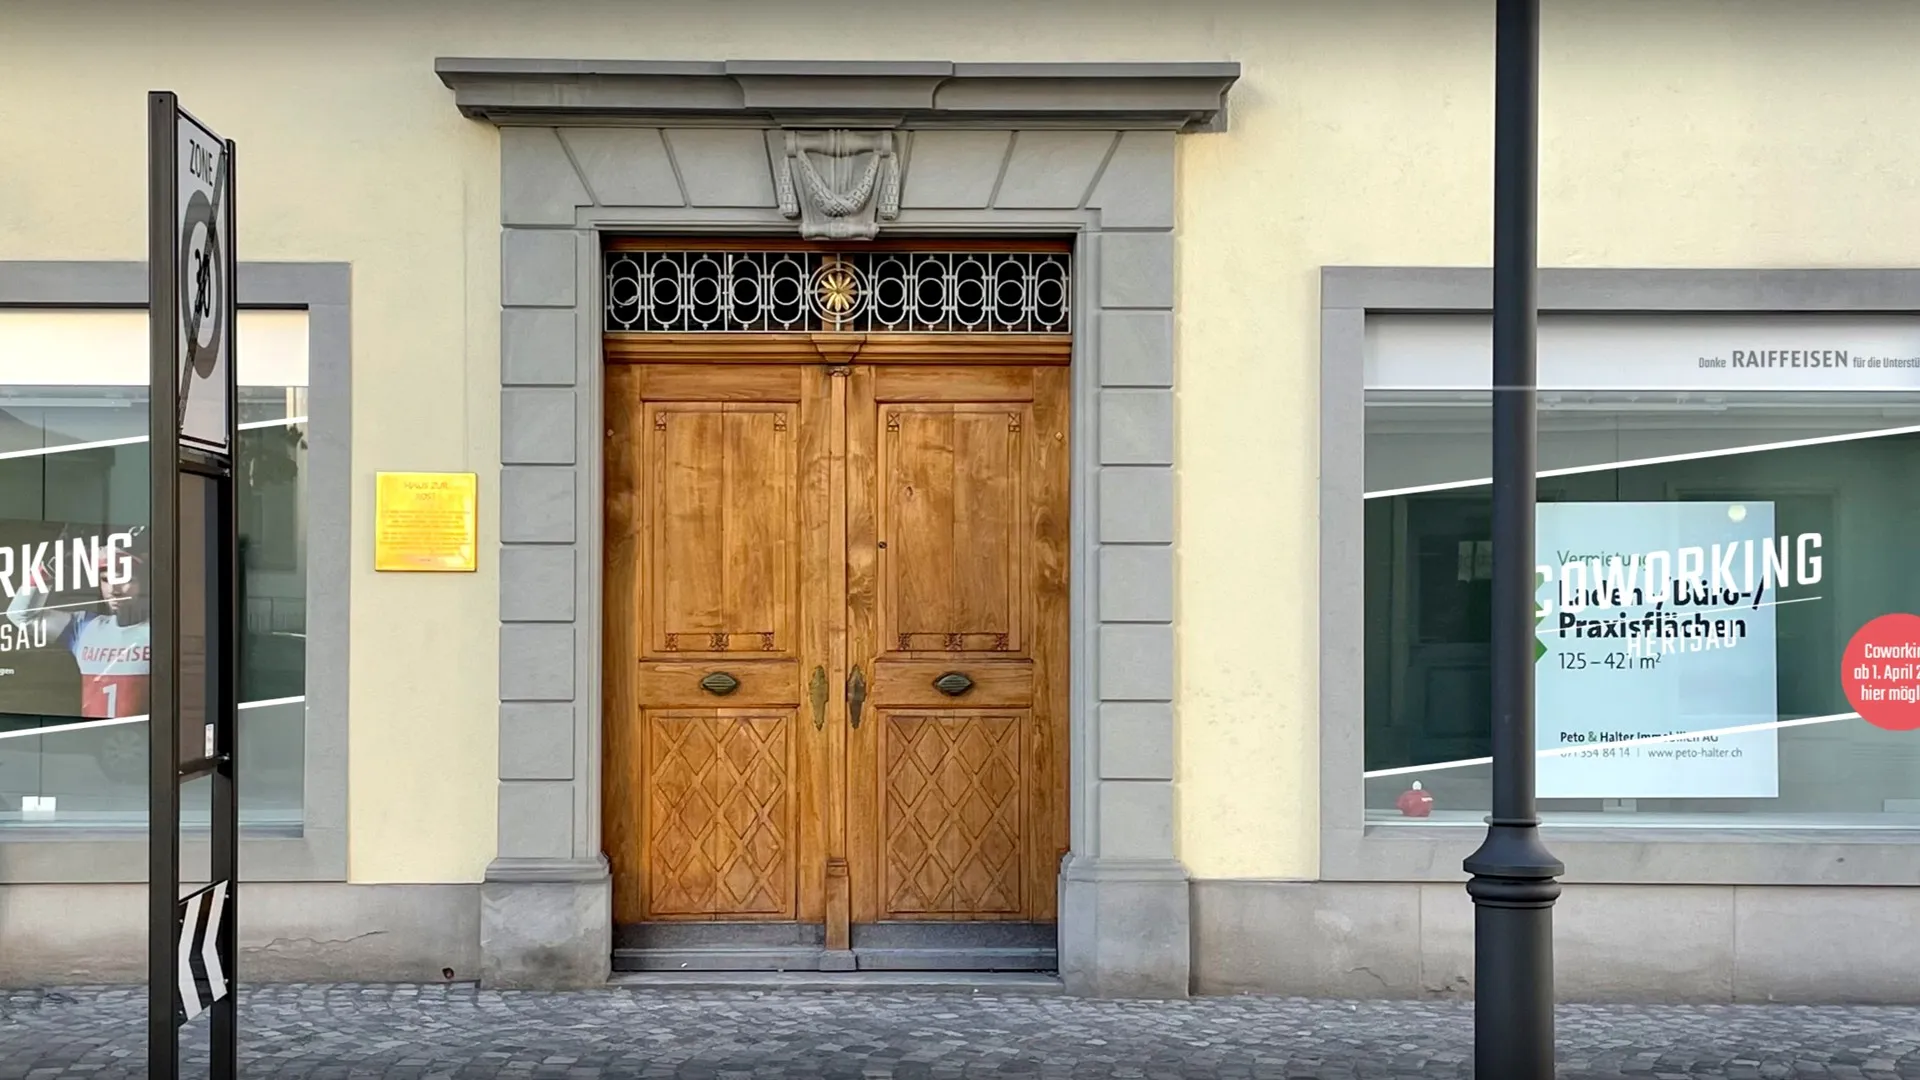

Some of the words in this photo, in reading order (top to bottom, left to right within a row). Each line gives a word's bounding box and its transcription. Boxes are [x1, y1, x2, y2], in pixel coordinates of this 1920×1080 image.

[189, 139, 213, 187] ZONE
[1699, 357, 1726, 368] Danke
[1732, 350, 1848, 368] RAIFFEISEN
[1853, 356, 1866, 368] für
[1867, 356, 1881, 368] die
[1557, 550, 1648, 571] Vermieu
[1535, 533, 1823, 617] COWORKING
[0, 619, 47, 652] SAU
[1559, 611, 1746, 638] Praxisflächen
[1626, 623, 1738, 659] HERISAU
[1853, 664, 1870, 680] ab
[1872, 664, 1881, 680] 1.
[1884, 664, 1913, 683] April
[102, 683, 118, 718] 1
[1861, 685, 1886, 701] hier
[1560, 731, 1585, 742] Peto
[1588, 731, 1598, 742] &
[1600, 731, 1634, 742] Halter
[1648, 747, 1743, 760] www.peto-halter.ch
